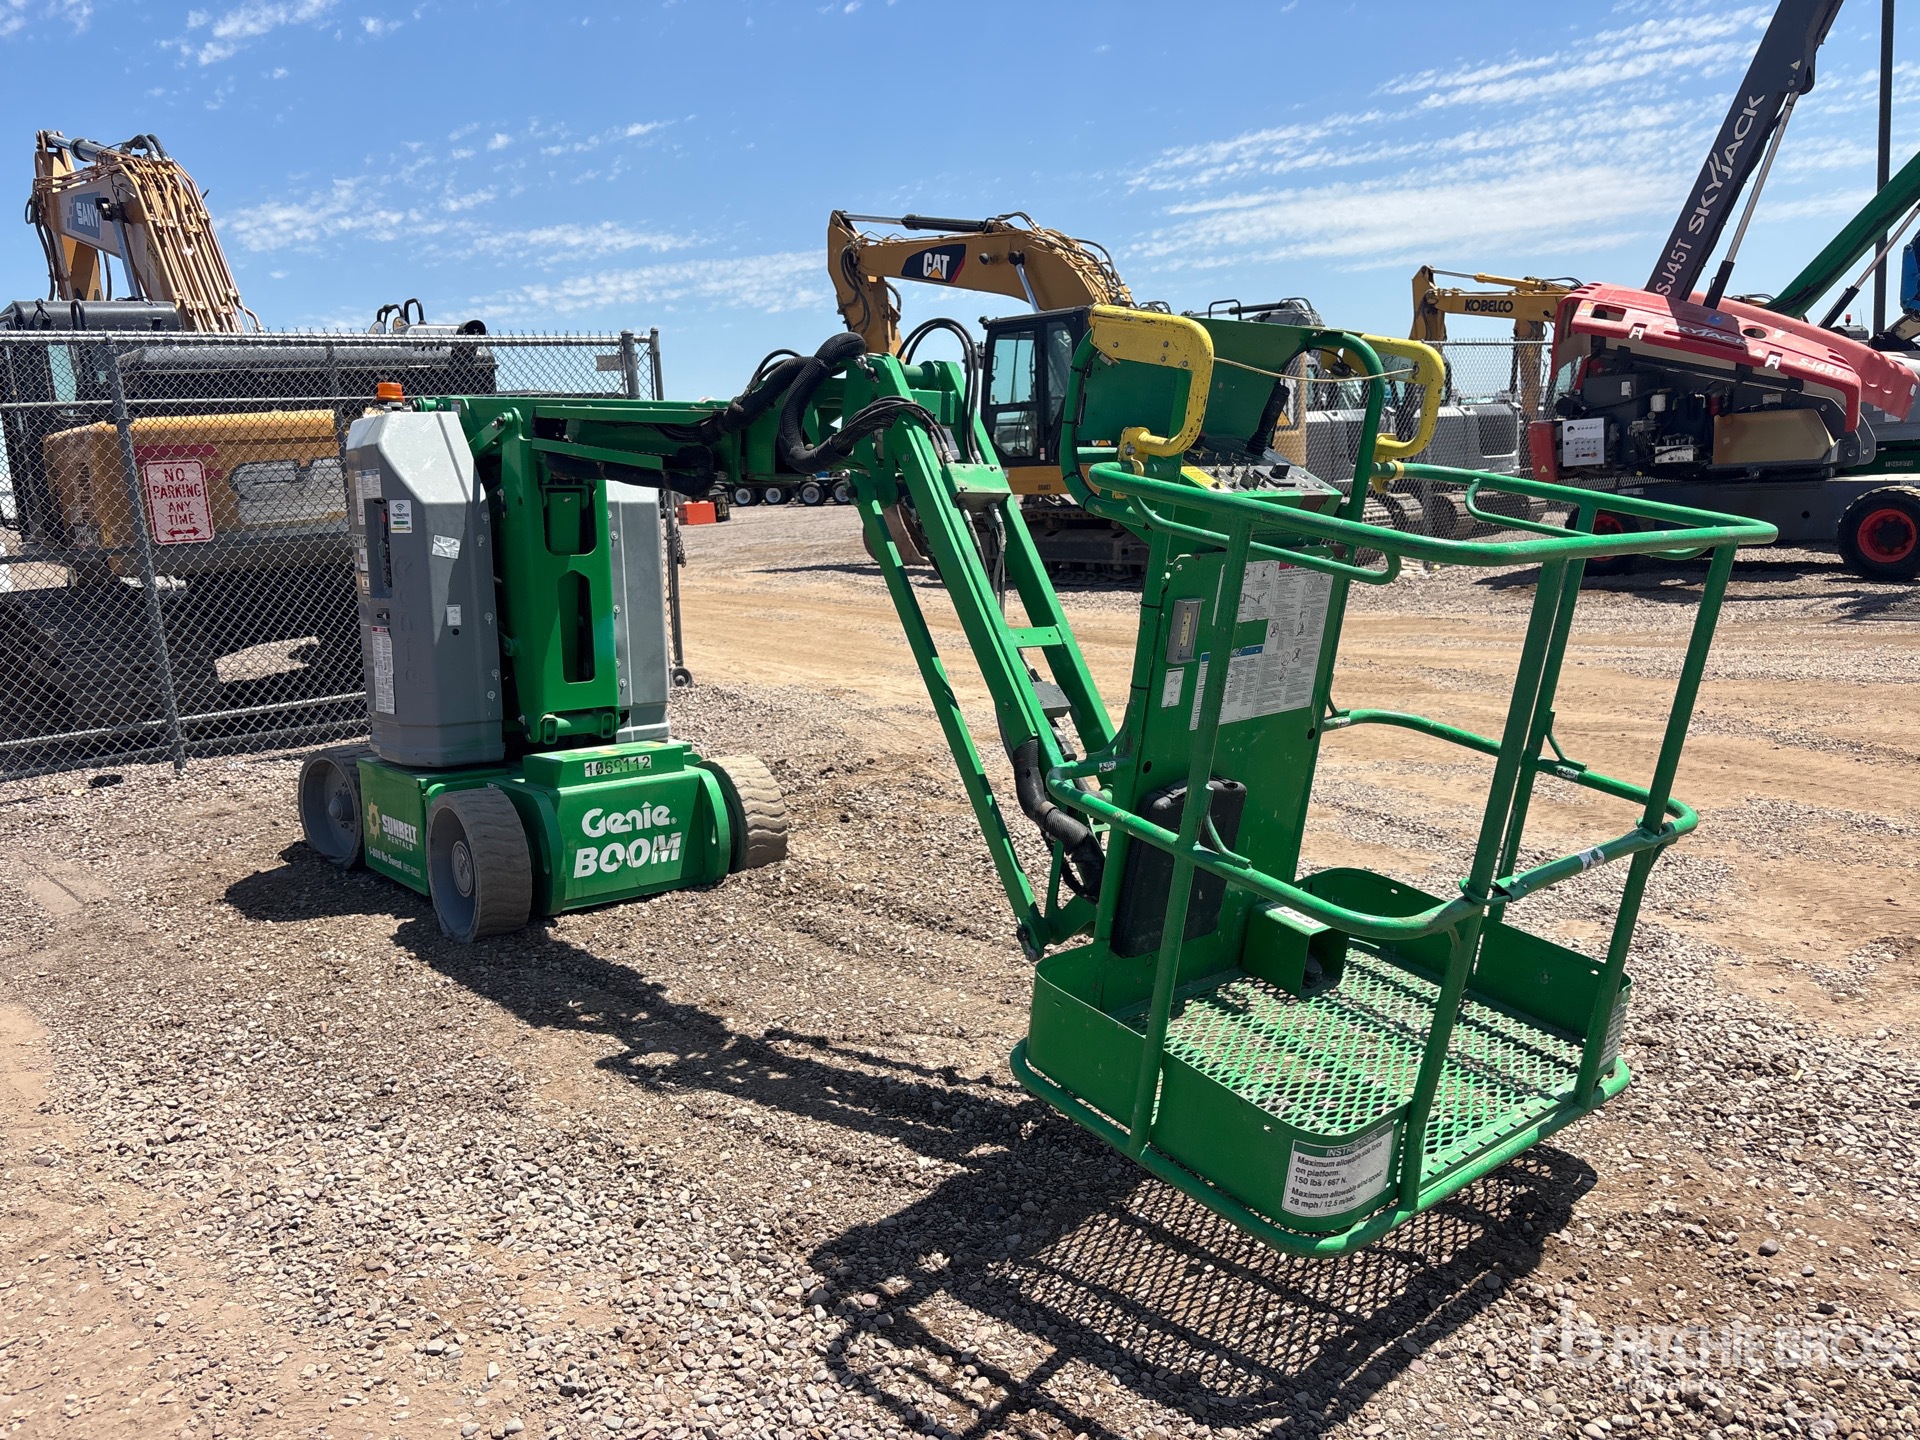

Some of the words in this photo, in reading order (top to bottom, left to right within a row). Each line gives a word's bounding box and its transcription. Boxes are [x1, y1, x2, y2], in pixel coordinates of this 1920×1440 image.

[1688, 94, 1766, 235] SKYJACK
[76, 202, 99, 228] SANY
[922, 252, 950, 280] CAT
[1655, 238, 1692, 296] SJ45T
[1464, 299, 1514, 313] KOBELCO
[163, 467, 185, 482] NO
[152, 483, 201, 499] PARKING
[168, 501, 191, 513] ANY
[168, 513, 196, 526] TIME
[581, 801, 671, 838] Genie
[381, 813, 417, 845] SUNBELT
[387, 834, 413, 851] RENTALS
[573, 832, 682, 879] BOOM
[1297, 1156, 1335, 1168] Maximum
[1294, 1175, 1308, 1185] 150
[1310, 1177, 1322, 1187] lbs
[1291, 1187, 1329, 1199] Maximum
[1289, 1197, 1299, 1206] 28
[1301, 1200, 1318, 1209] mph
[1324, 1199, 1338, 1208] 12.5
